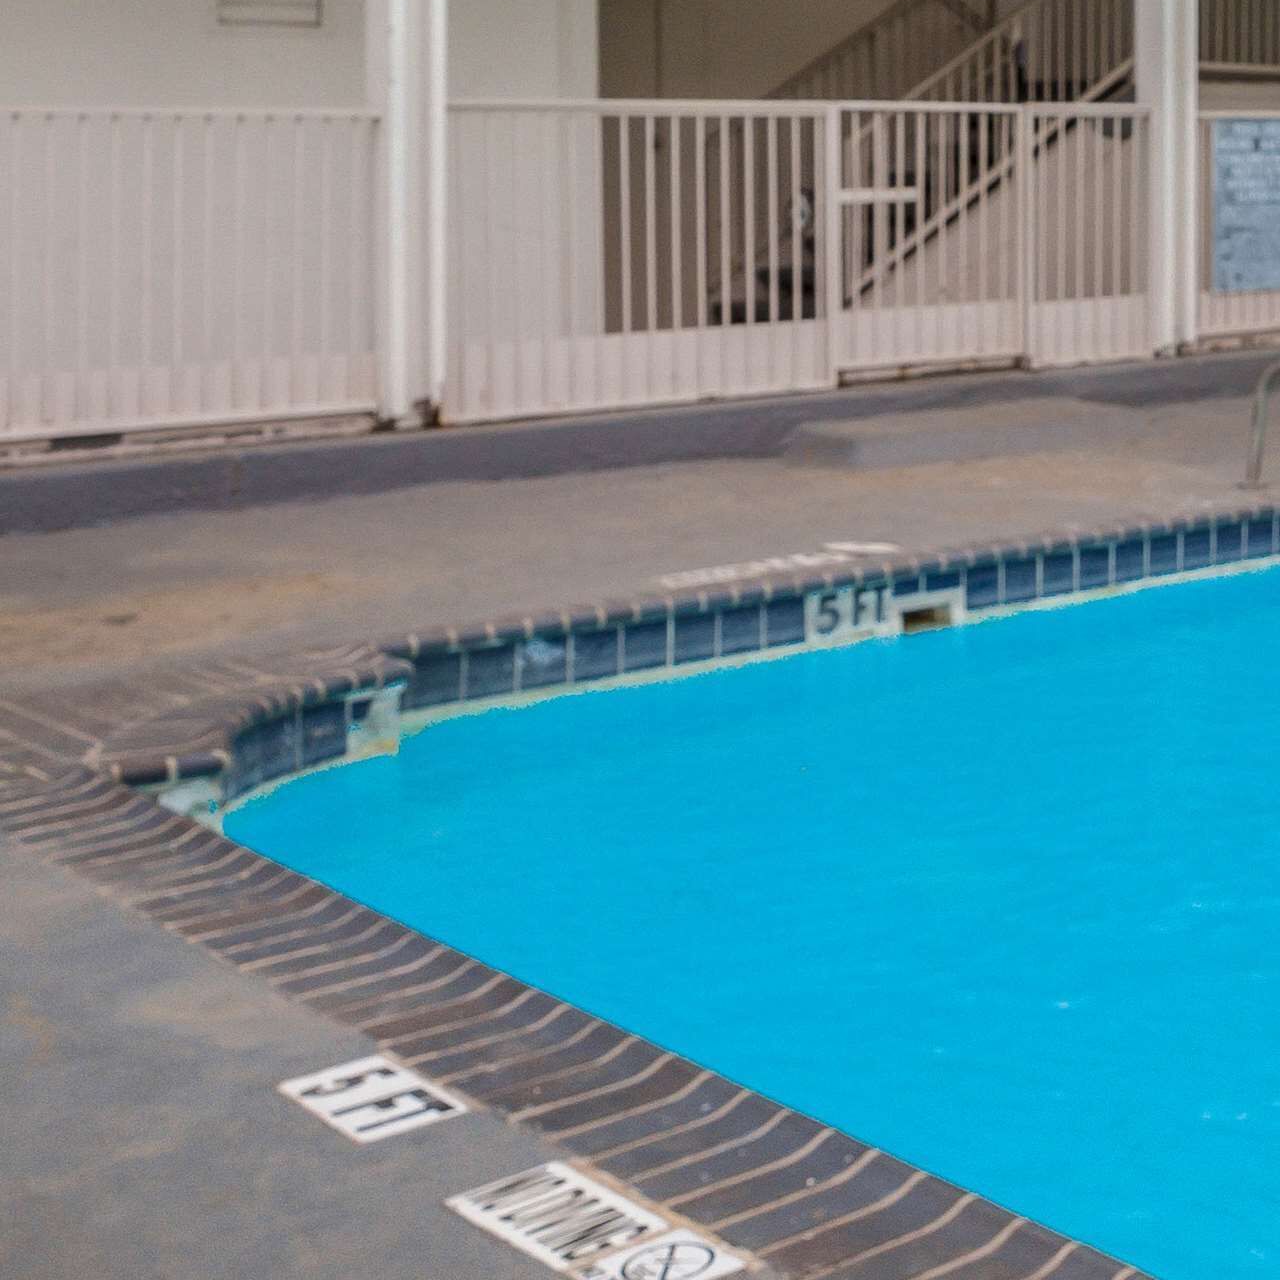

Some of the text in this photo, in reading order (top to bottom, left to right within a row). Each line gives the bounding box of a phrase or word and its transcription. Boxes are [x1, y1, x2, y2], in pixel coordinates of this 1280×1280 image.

[817, 587, 886, 635] 5 FT
[300, 1068, 455, 1133] 5 FT
[464, 1167, 649, 1261] NO DIVING
